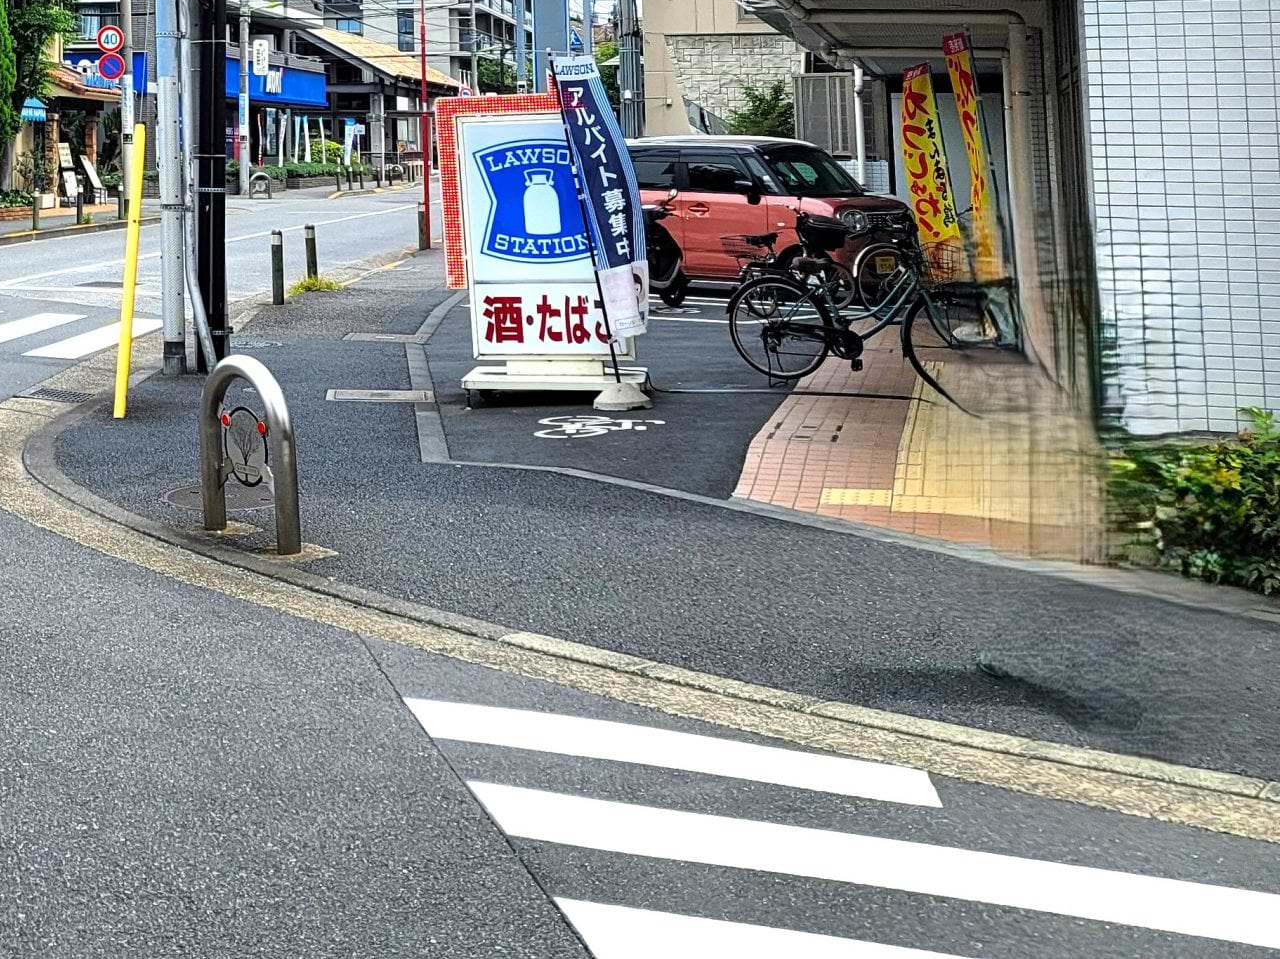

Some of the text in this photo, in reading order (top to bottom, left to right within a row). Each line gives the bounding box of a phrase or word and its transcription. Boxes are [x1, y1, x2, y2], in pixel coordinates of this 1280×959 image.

[103, 33, 118, 45] 40
[554, 62, 596, 77] LAWSON
[485, 148, 571, 172] LAWSO
[567, 86, 631, 261] アルバイト募集中
